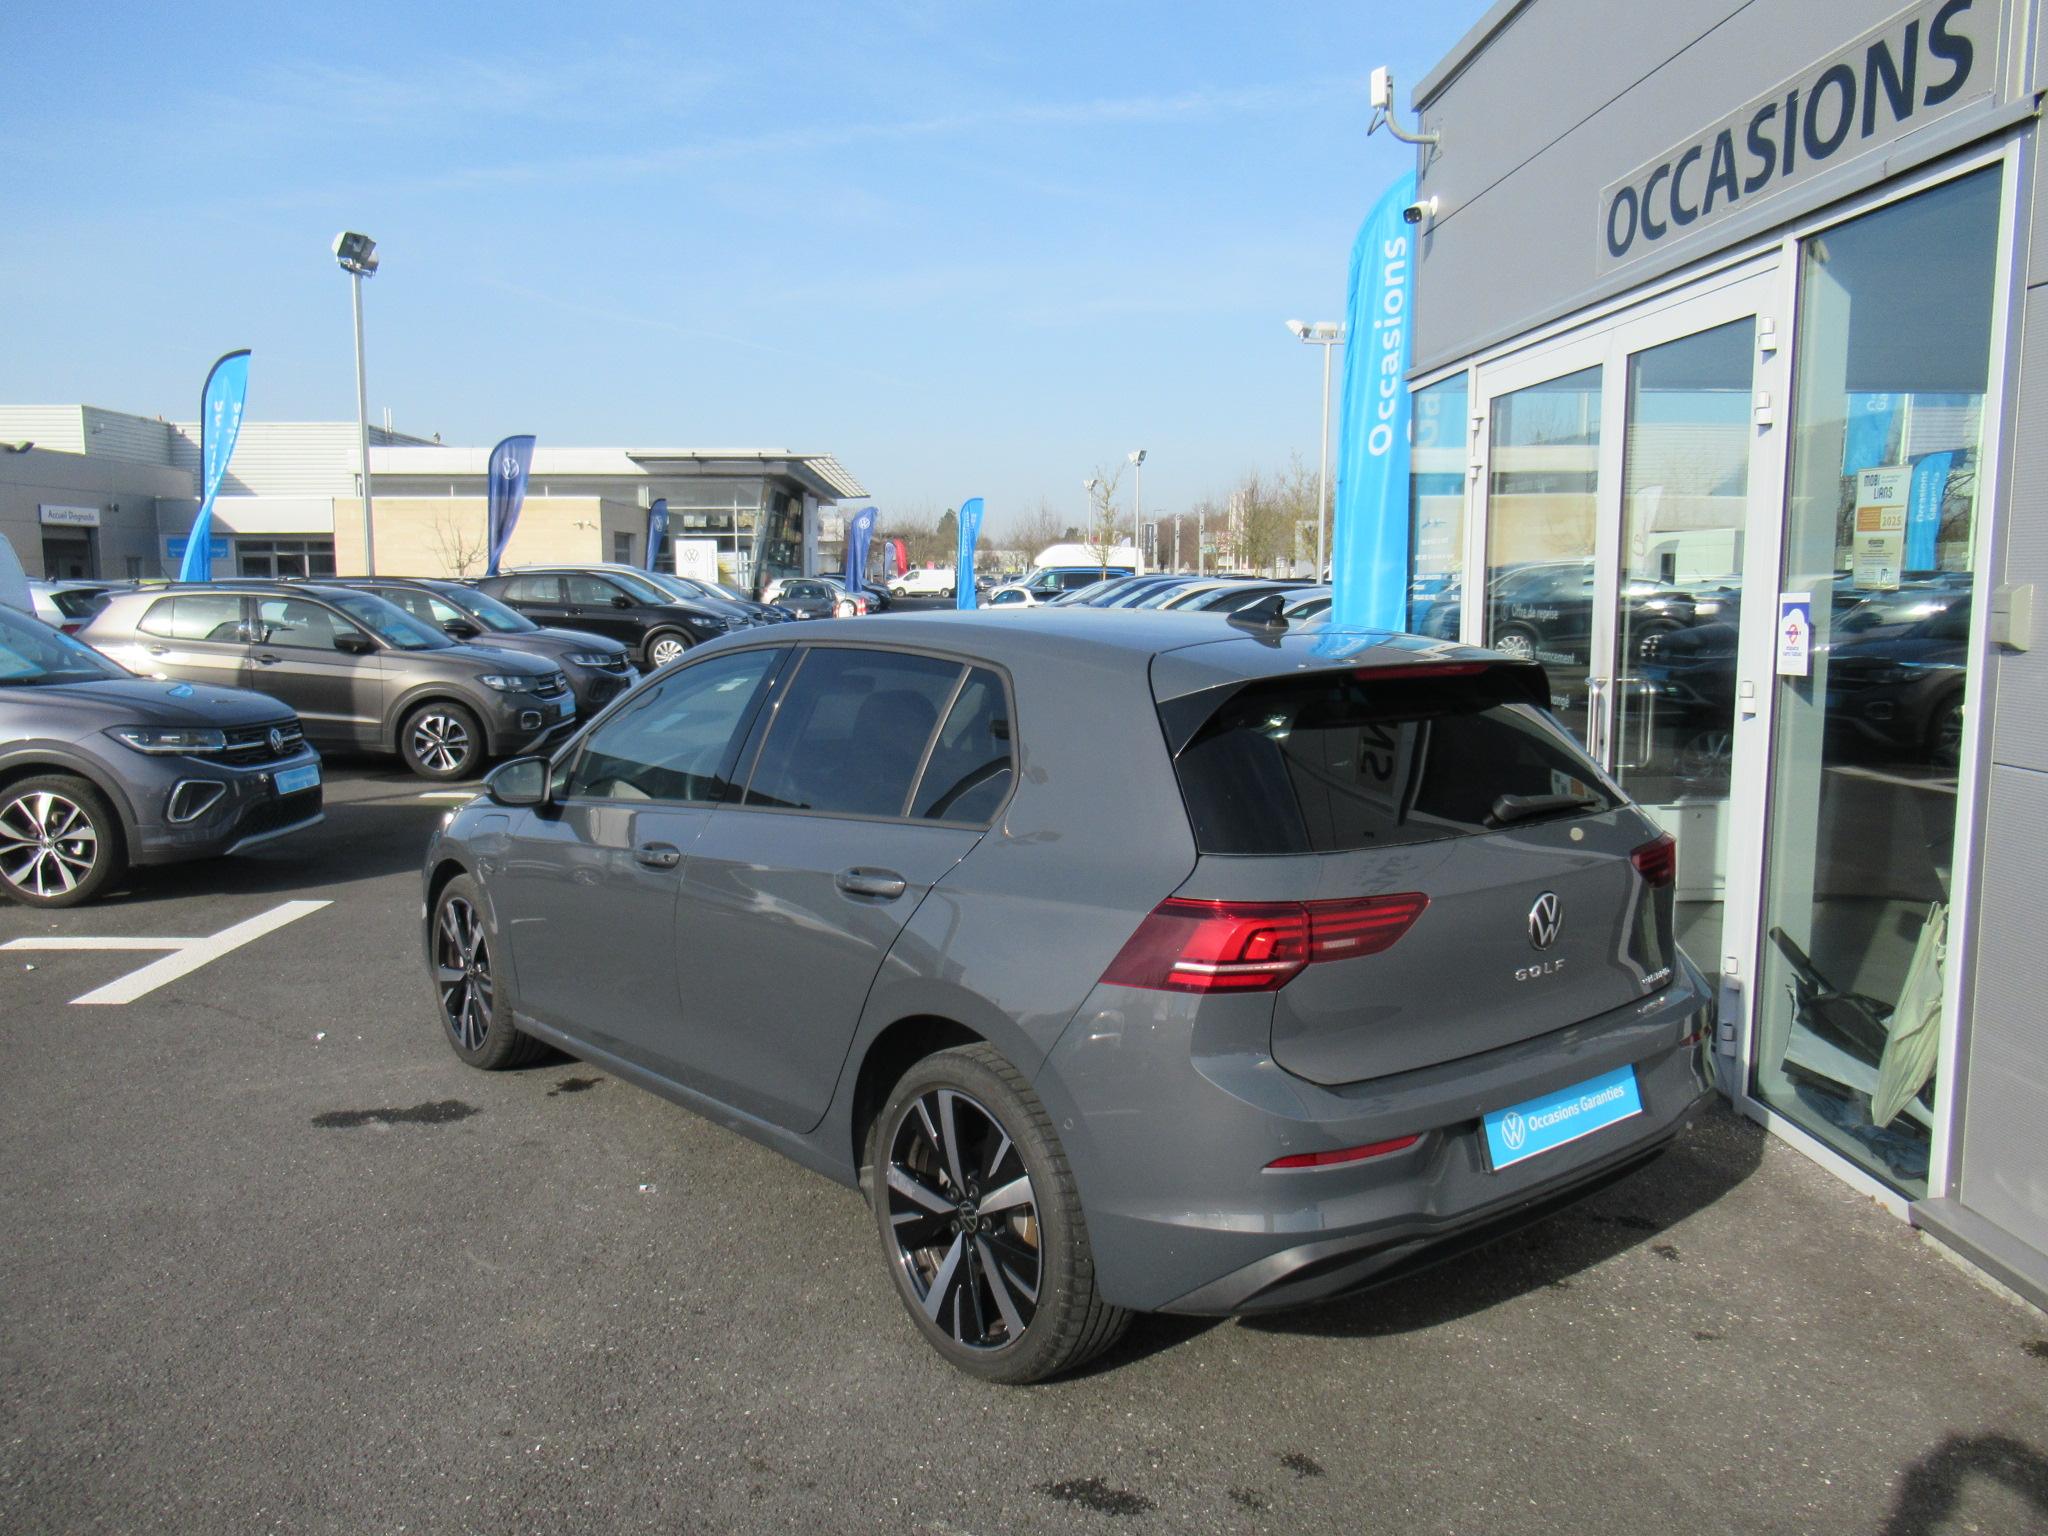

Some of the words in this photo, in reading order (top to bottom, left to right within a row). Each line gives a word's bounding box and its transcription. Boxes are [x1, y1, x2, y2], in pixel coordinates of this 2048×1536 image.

[1607, 0, 1974, 258] OCCASIONS
[1368, 236, 1407, 457] Occasions
[1515, 958, 1565, 982] GOLF
[1528, 1103, 1580, 1132] Occasions
[1580, 1085, 1625, 1111] Garanties
